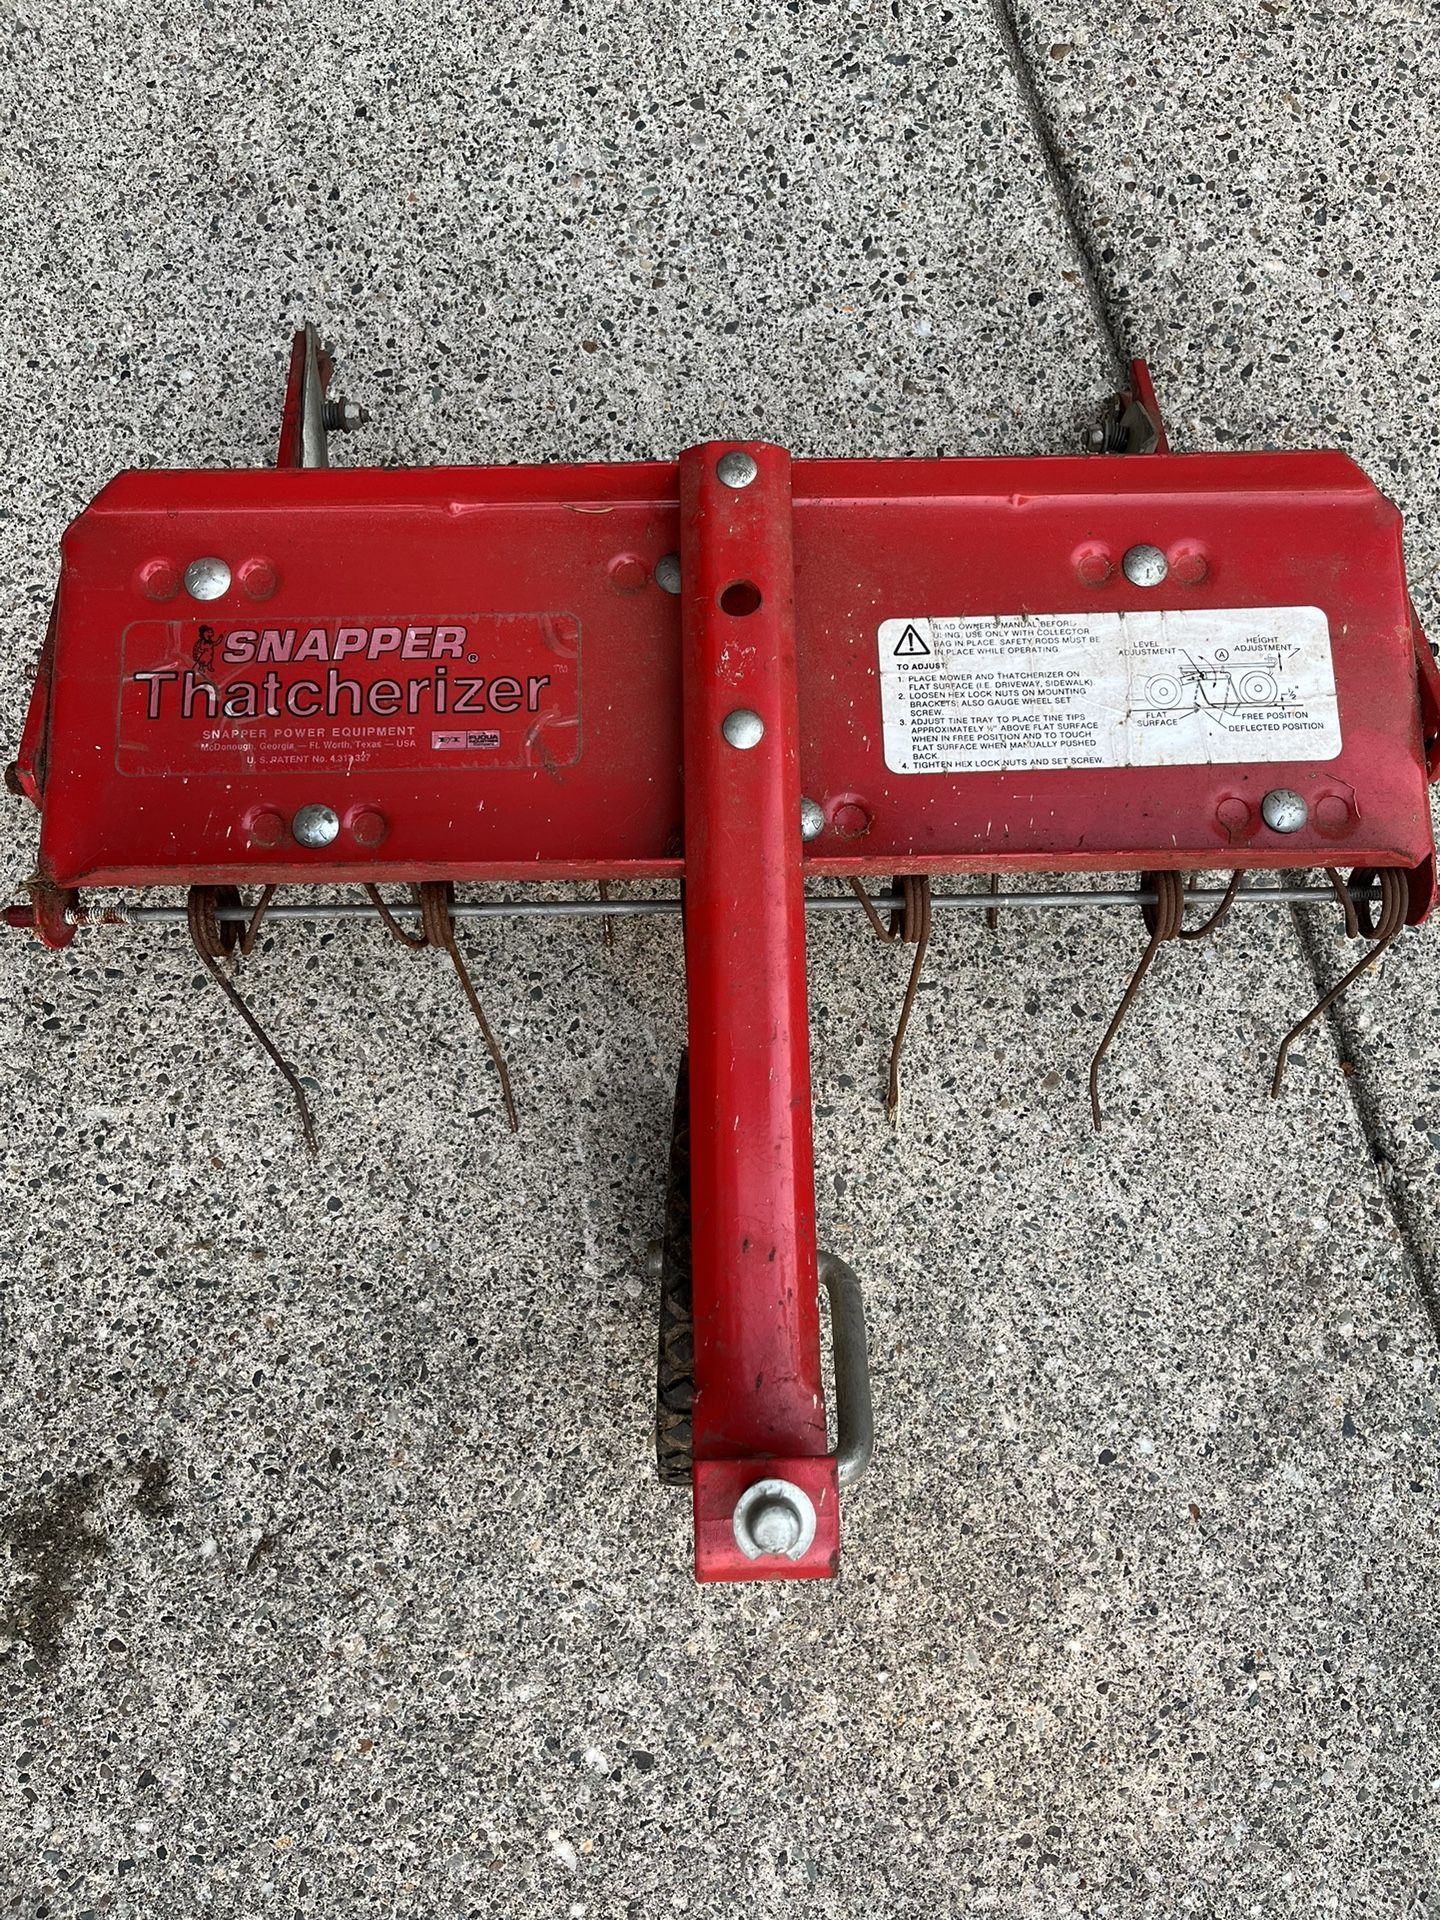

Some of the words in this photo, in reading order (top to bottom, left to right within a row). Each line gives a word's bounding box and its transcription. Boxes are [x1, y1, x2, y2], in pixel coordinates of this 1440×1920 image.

[223, 625, 468, 664] SNAPPER
[1062, 636, 1086, 644] MUST
[1007, 646, 1059, 654] OPERATING
[1118, 648, 1176, 656] ADJUSTMENT
[1234, 643, 1292, 651] ADJUSTMENT
[939, 673, 973, 681] MOWER
[997, 671, 1063, 680] THATCHERIZER
[933, 682, 973, 690] SURFACE
[995, 680, 1043, 689] DRIVEWAY,
[133, 666, 551, 719] Thatcherizer
[909, 691, 946, 699] LOOSEN
[968, 690, 993, 698] LOCK
[1038, 687, 1086, 696] MOUNTING
[1022, 697, 1052, 705] WHEEL
[910, 709, 944, 717] SCREW.
[1267, 711, 1309, 719] POSITION
[911, 725, 983, 734] APPROXIMATELY
[1057, 722, 1099, 730] SURFACE
[1137, 719, 1178, 727] SURFACE
[1229, 724, 1280, 732] DEFLECTED
[1282, 722, 1324, 730] POSITION
[203, 729, 267, 739] SNAPPER
[274, 728, 325, 738] POWER
[332, 726, 415, 737] EQUIPMENT
[977, 733, 1020, 741] POSITION
[201, 743, 256, 752] McDonough,
[260, 742, 294, 751] Georgia
[936, 742, 978, 750] SURFACE
[1009, 740, 1058, 749] MANUALLY
[270, 755, 309, 763] PATENT
[312, 755, 327, 763] No.
[913, 760, 952, 769] TIGHTEN
[975, 759, 1000, 767] LOCK
[1003, 758, 1027, 766] NUTS
[1052, 757, 1068, 765] SET
[1071, 756, 1105, 764] SCREW.
